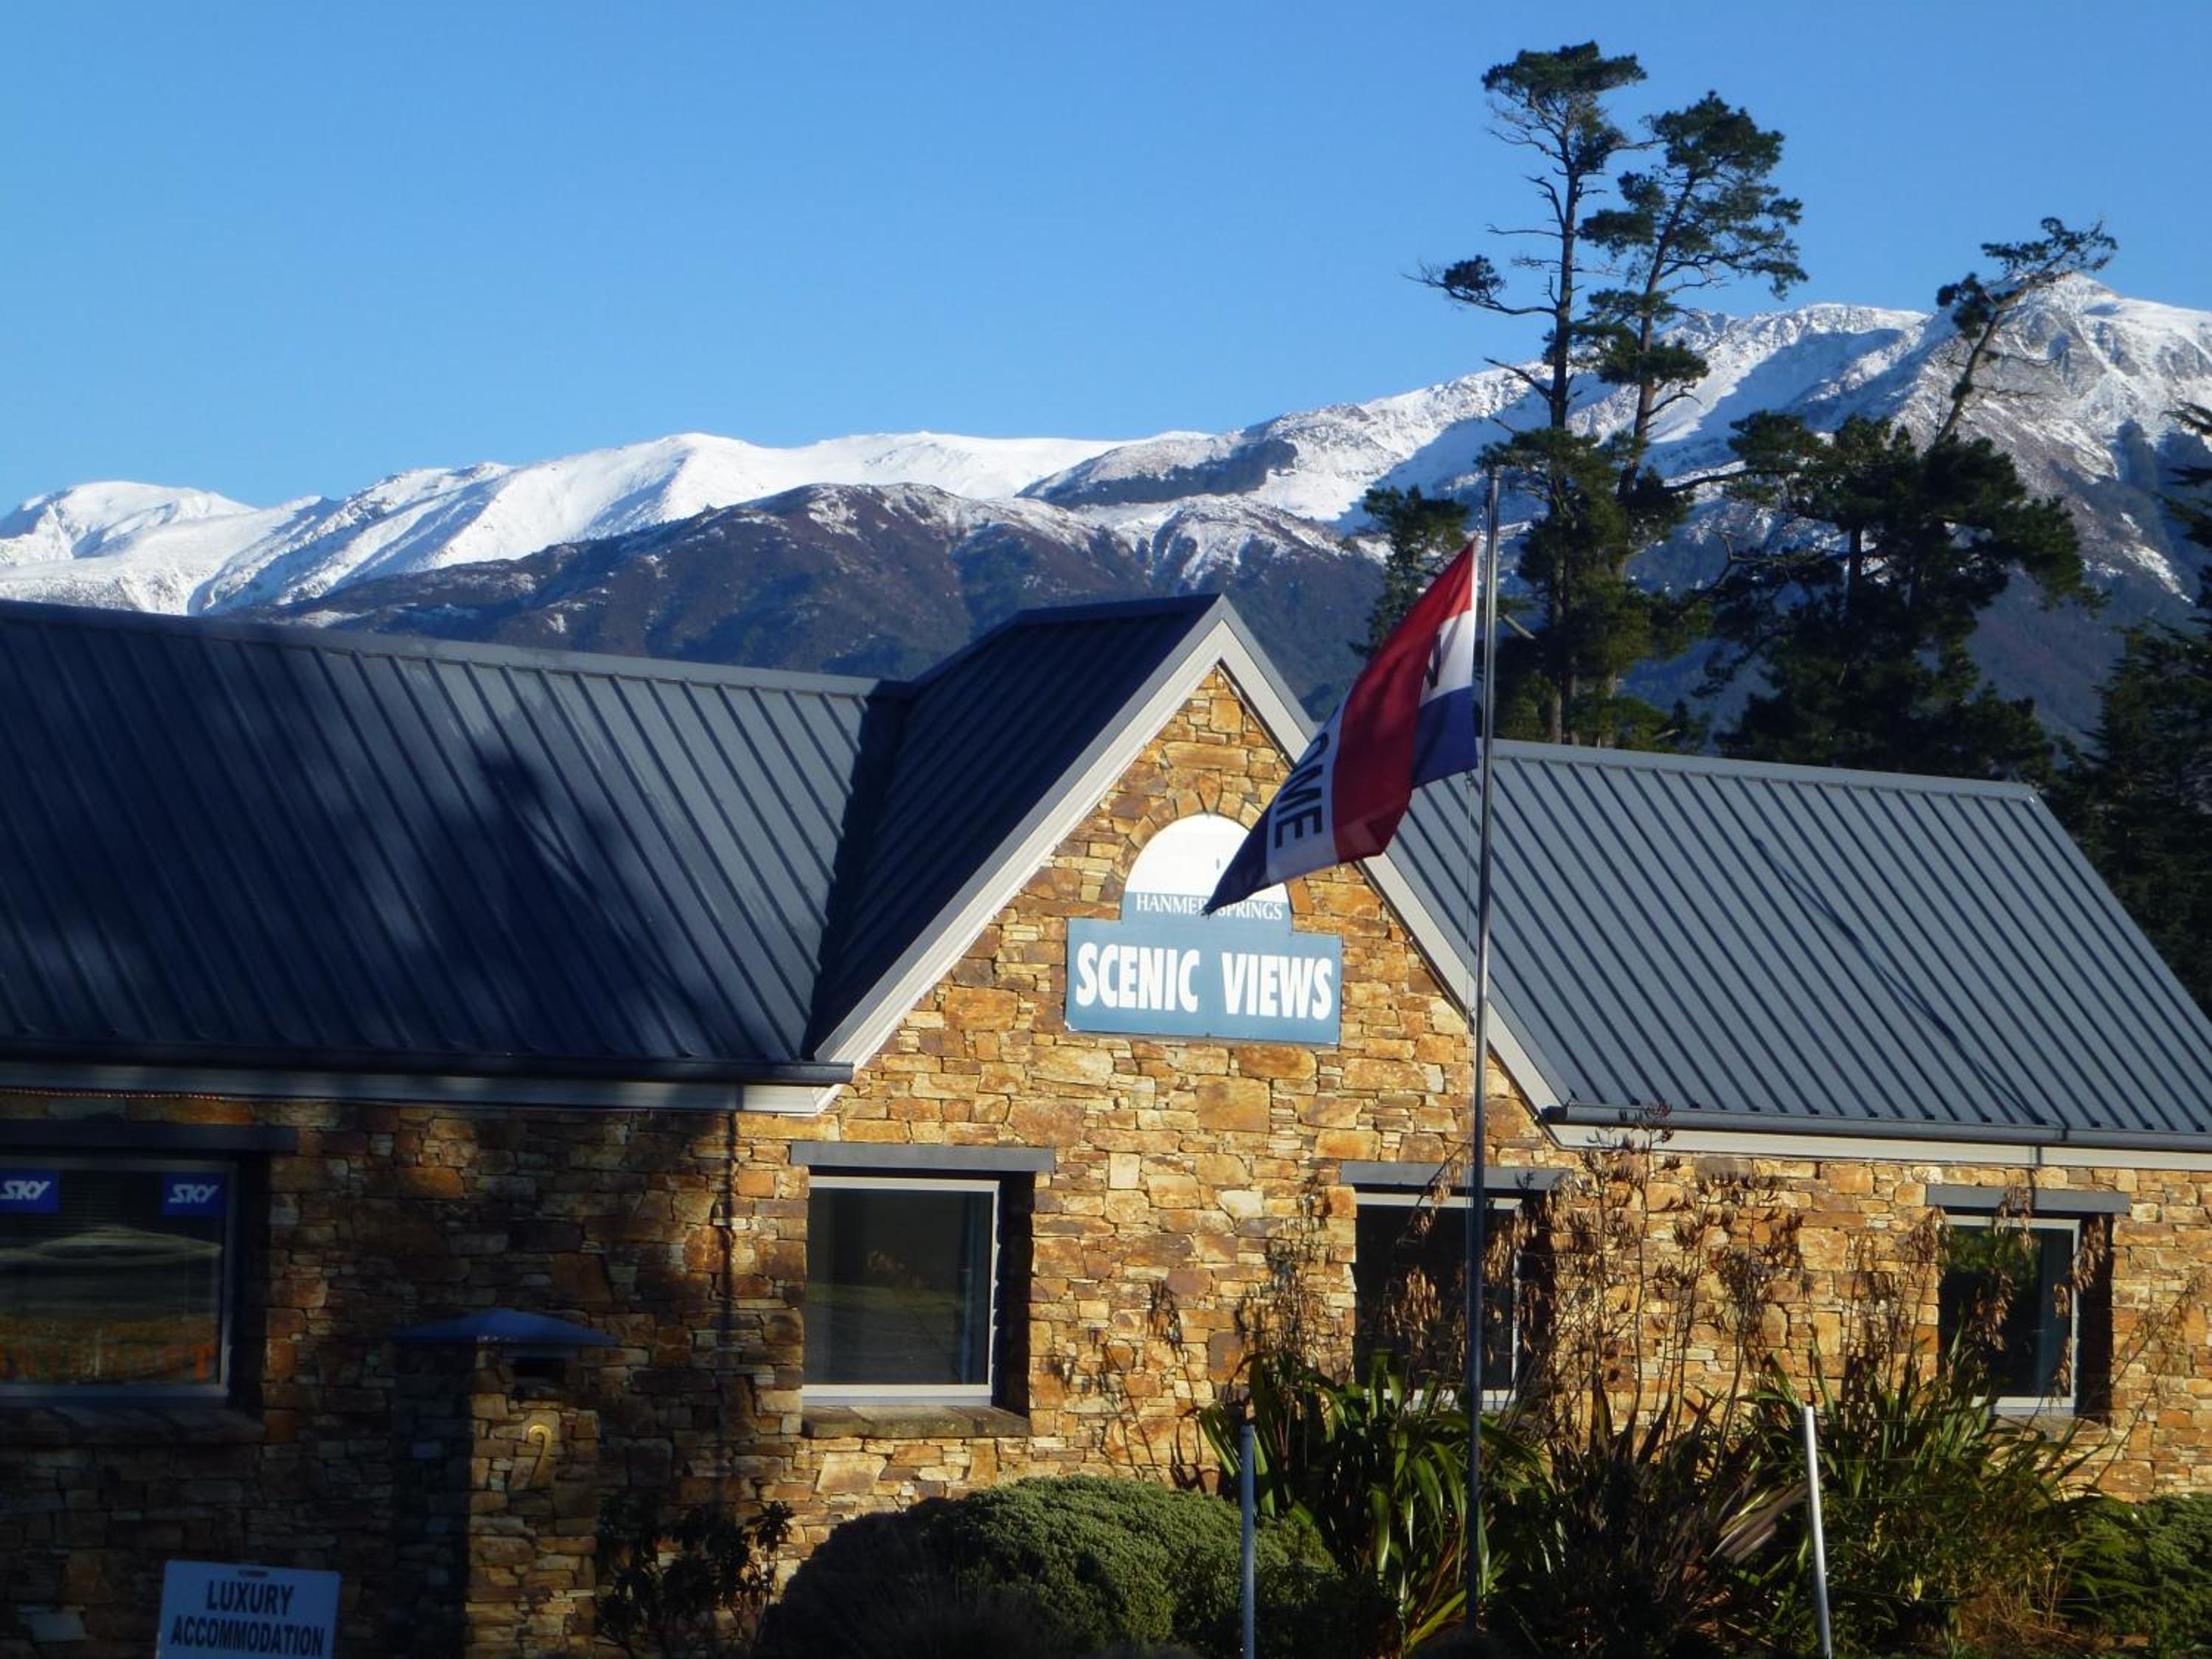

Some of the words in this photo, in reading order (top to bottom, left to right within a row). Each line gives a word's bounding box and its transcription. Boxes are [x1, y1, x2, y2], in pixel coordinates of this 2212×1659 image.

[1075, 942, 1200, 1013] SCENIC
[1222, 952, 1333, 1020] VIEWS
[0, 1180, 51, 1200] SKY
[167, 1183, 218, 1204] SKY
[206, 1580, 294, 1615] LUXURY
[170, 1614, 324, 1656] ACCOMMODATION
